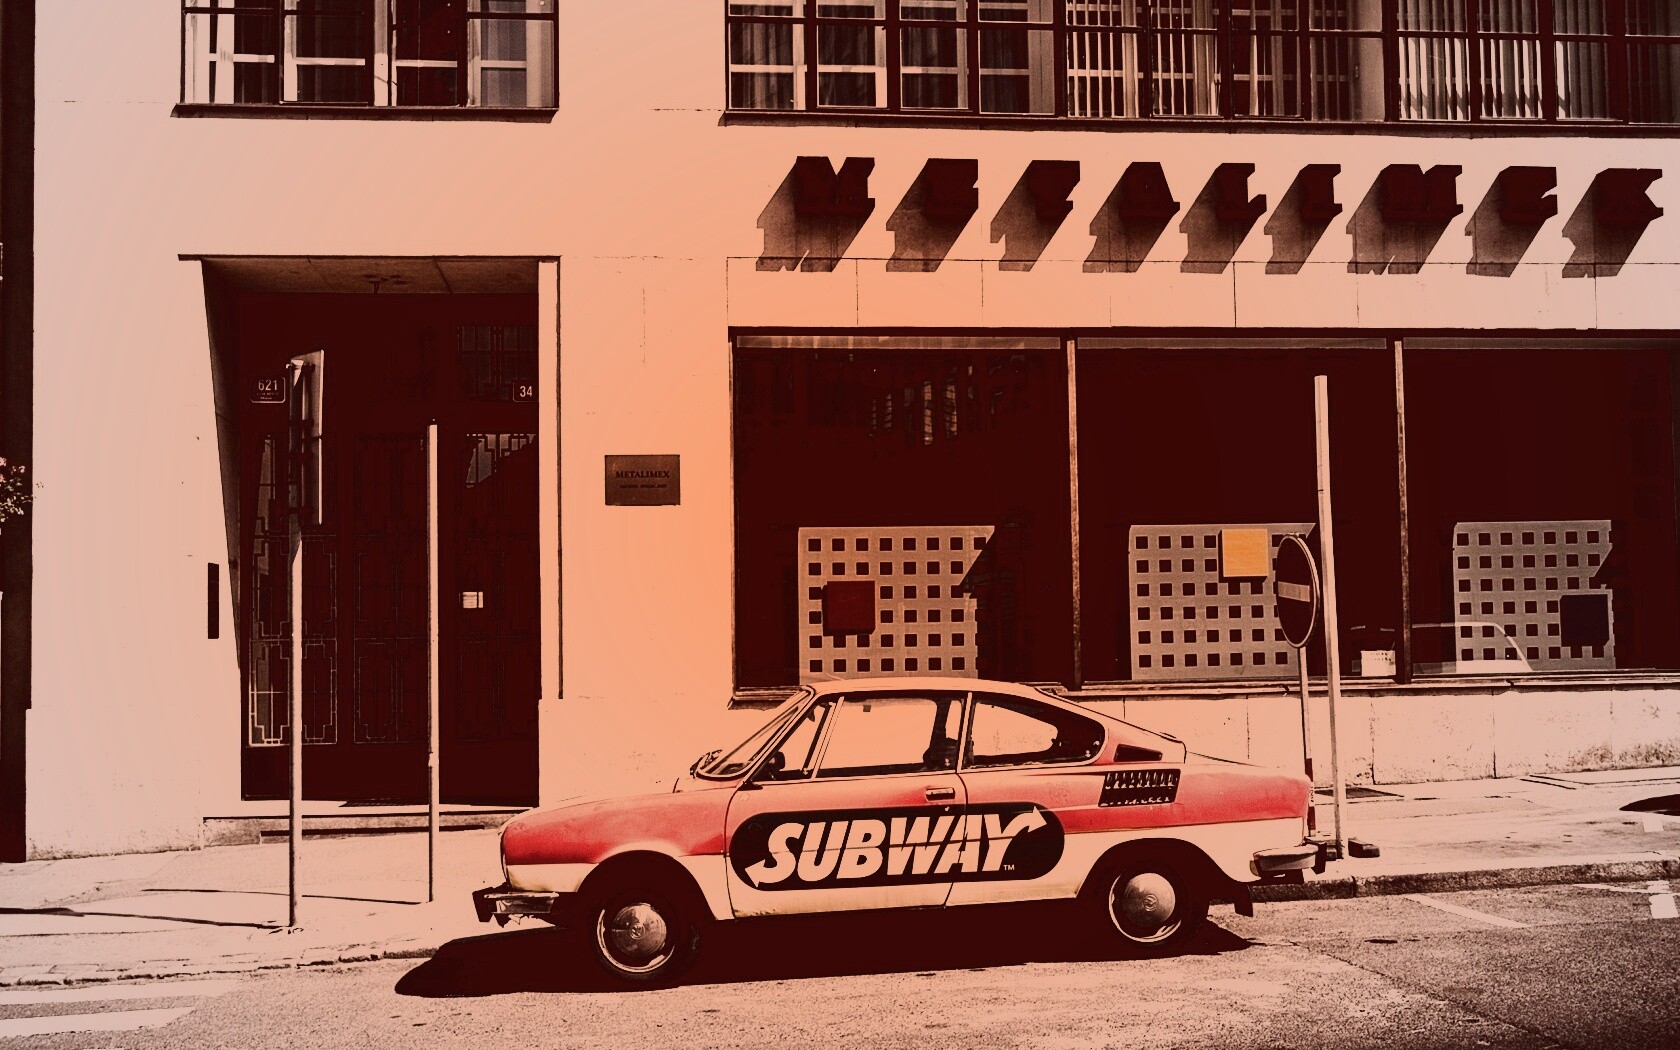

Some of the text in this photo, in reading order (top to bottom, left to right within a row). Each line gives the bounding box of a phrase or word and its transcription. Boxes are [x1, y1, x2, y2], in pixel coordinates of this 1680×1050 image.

[258, 379, 278, 391] 621
[519, 385, 533, 398] 34
[615, 470, 670, 479] METALIMEX
[745, 806, 1047, 887] SUBWAY
